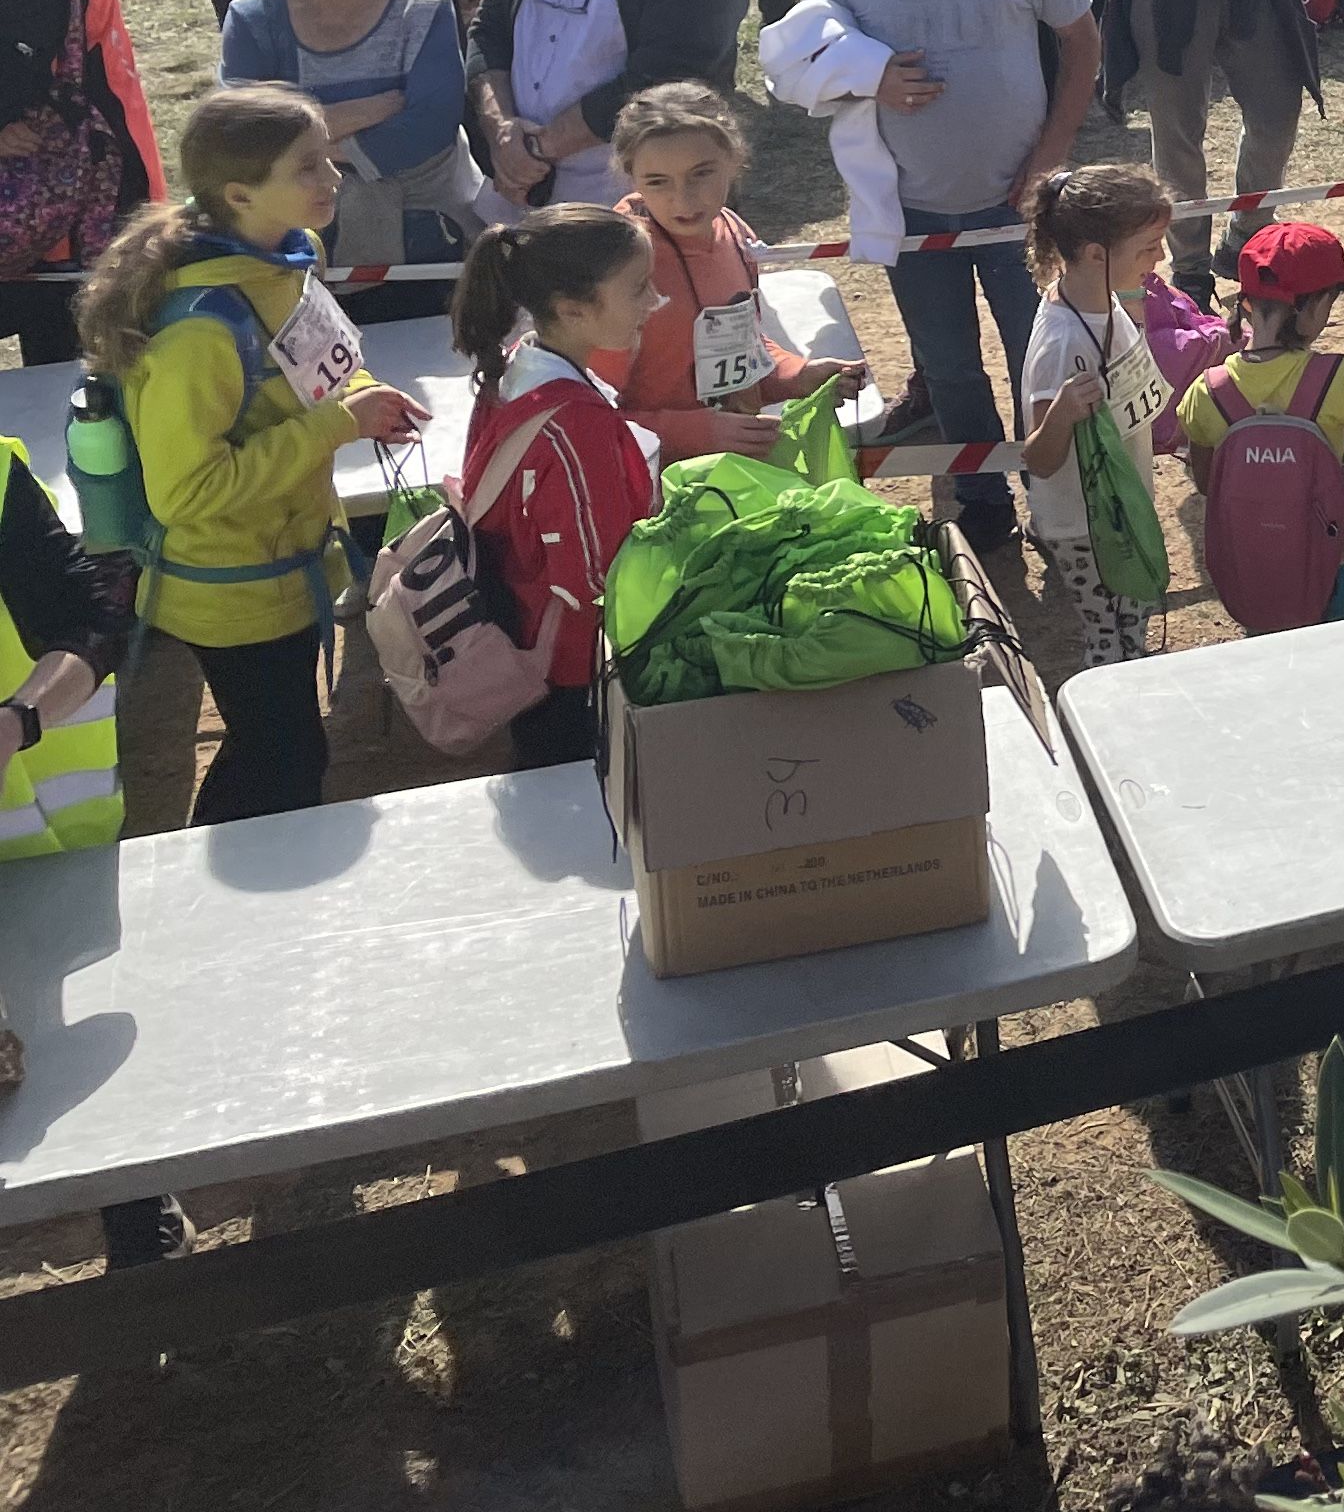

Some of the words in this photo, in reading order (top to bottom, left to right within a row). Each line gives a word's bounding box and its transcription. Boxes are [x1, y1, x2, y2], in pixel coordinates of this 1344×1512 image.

[316, 333, 358, 392] 19
[712, 354, 748, 388] 15
[1123, 379, 1162, 430] 115
[1245, 446, 1297, 464] NAIA
[697, 891, 736, 909] MADE
[739, 889, 753, 903] IN
[756, 884, 798, 901] CHINA
[800, 879, 818, 893] TO
[821, 875, 846, 890] THE
